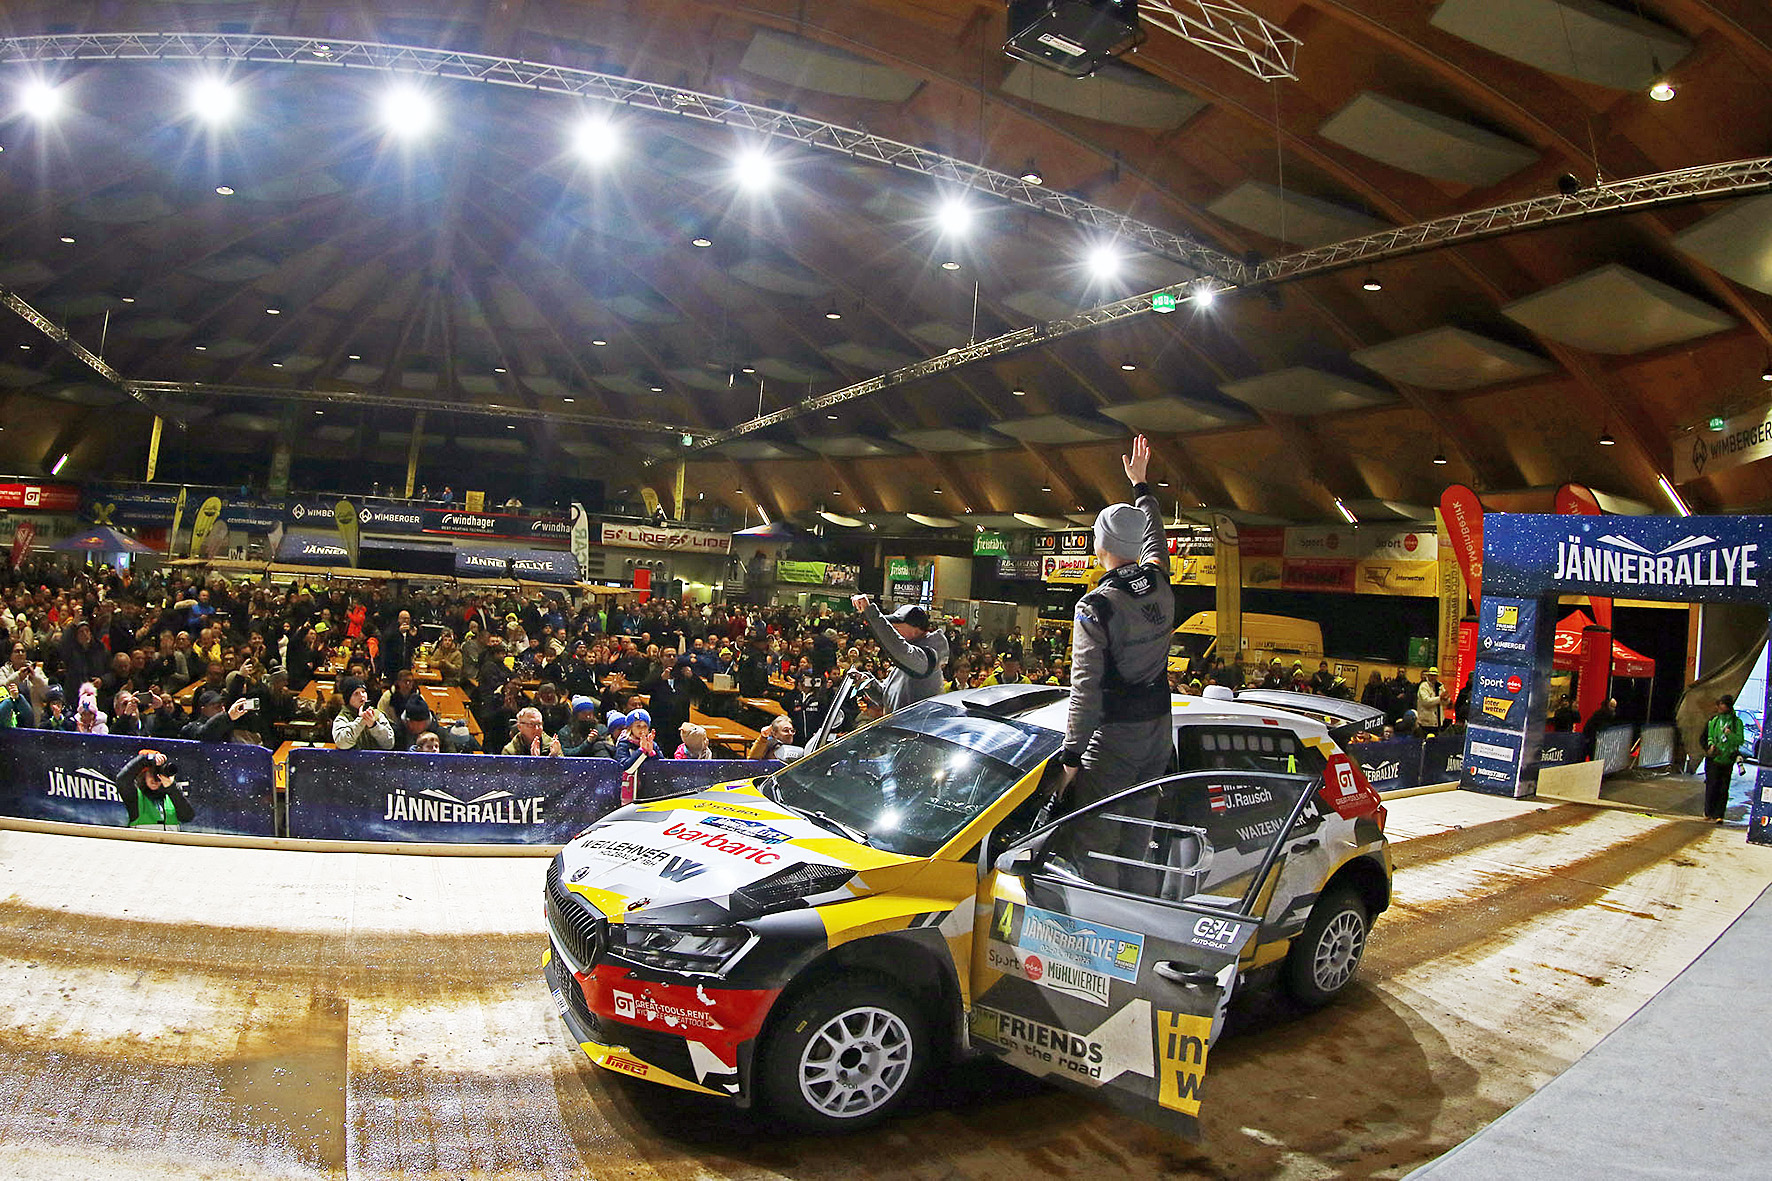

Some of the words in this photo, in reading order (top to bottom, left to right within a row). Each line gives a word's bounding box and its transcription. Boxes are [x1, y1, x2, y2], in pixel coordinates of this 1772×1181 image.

[1710, 421, 1772, 459] WIMBERGER
[374, 512, 420, 524] WIMBERGER
[452, 514, 495, 528] windhager
[1035, 536, 1053, 547] LTO
[1064, 535, 1085, 547] LTO
[465, 556, 553, 571] JÄNNEALLYE
[1554, 535, 1758, 587] JÄNNERRALLYE
[1131, 578, 1148, 590] OMP
[1494, 640, 1526, 650] WIMBERGER
[1480, 675, 1504, 689] Sport
[1484, 697, 1500, 706] inter
[1485, 703, 1507, 713] wetten
[1364, 715, 1384, 730] brr.at
[1340, 770, 1353, 788] GT
[384, 789, 545, 824] JÄNNERRALLYE
[1226, 788, 1273, 809] J.Rausch
[663, 822, 781, 865] barbaric
[1000, 902, 1014, 938] 4
[1023, 914, 1116, 961] JÄNNERRALLYE
[989, 948, 1020, 971] Sport
[1047, 961, 1108, 996] MÜHLVIERTEL
[616, 996, 633, 1012] GT
[635, 999, 709, 1020] GREAT-TOOLS.RENT
[1000, 1014, 1104, 1064] FRIENDS
[605, 1055, 649, 1076] PIRELLI
[1001, 1036, 1018, 1053] on
[1024, 1043, 1052, 1062] the
[1058, 1057, 1102, 1079] road
